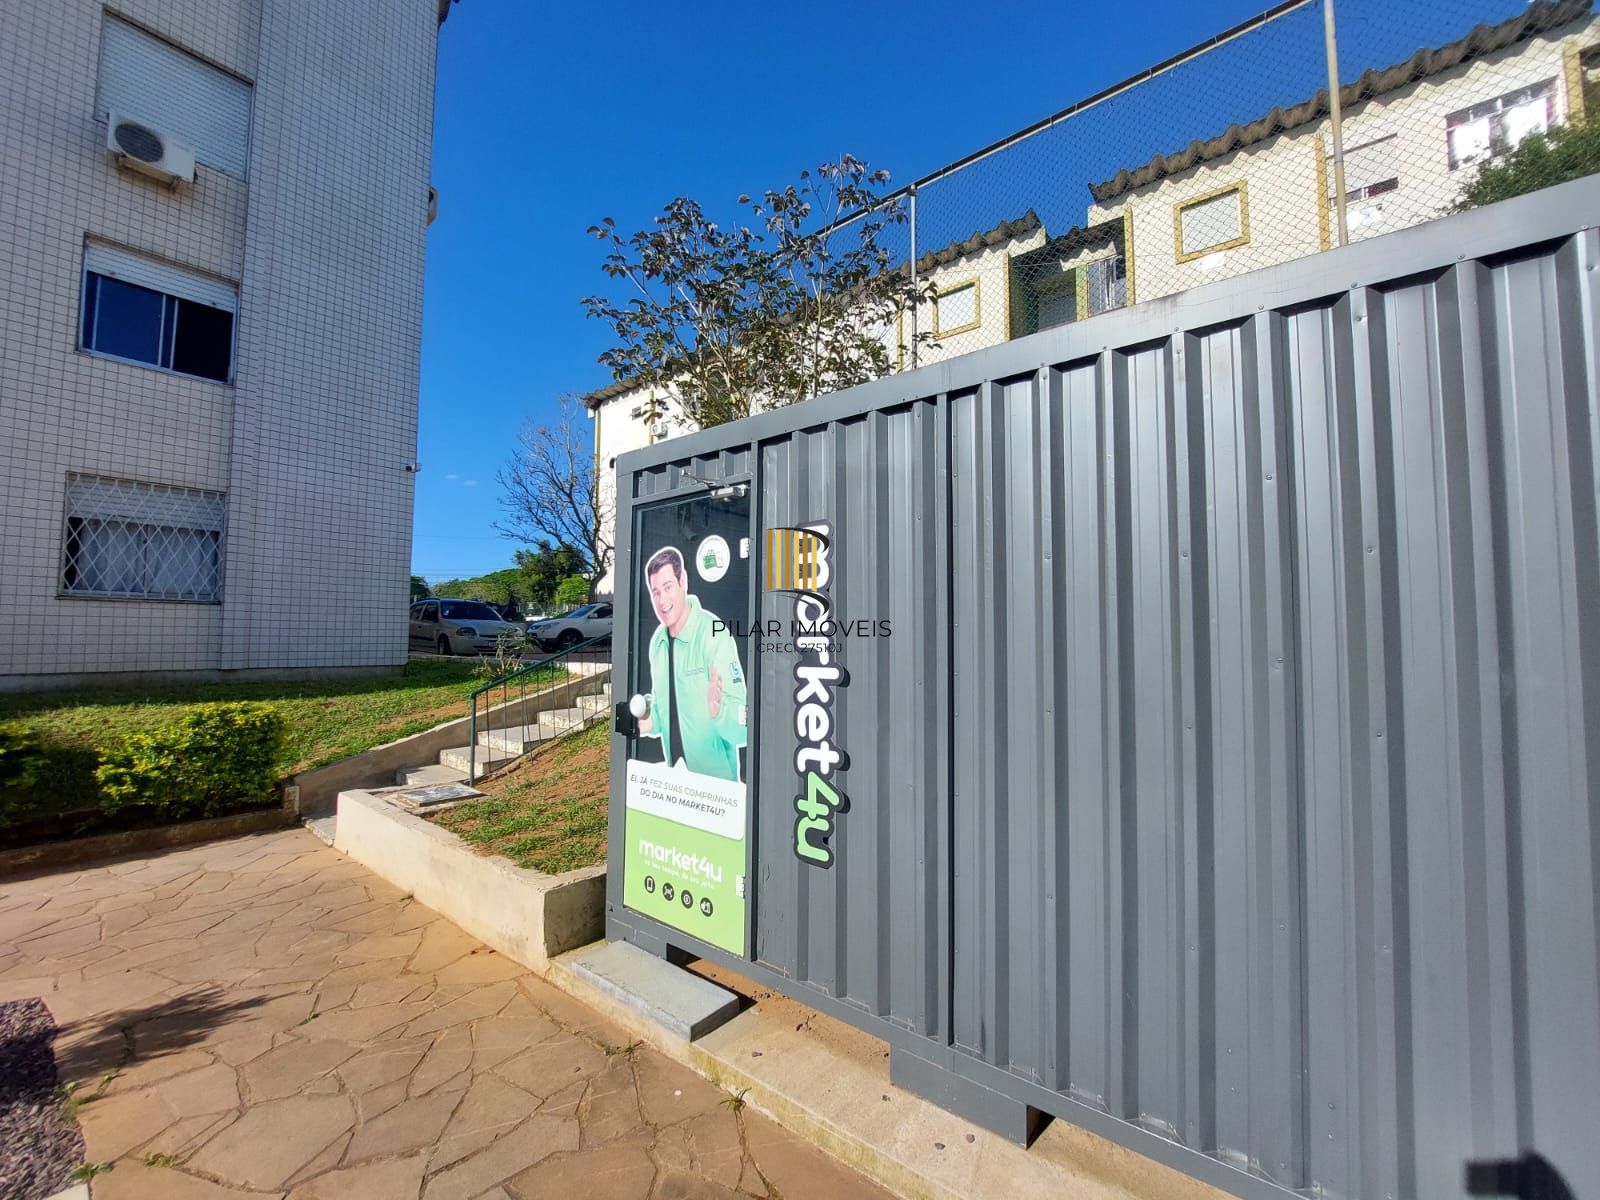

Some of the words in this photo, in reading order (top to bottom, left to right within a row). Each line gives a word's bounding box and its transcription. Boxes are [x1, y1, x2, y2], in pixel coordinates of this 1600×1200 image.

[797, 524, 840, 862] market4u
[640, 776, 648, 785] JÁ
[649, 779, 661, 788] FEZ
[664, 782, 682, 793] SUAS
[684, 787, 738, 807] COMPRINHAS
[640, 788, 651, 797] DO
[652, 791, 664, 801] DIA
[666, 795, 677, 804] NO
[679, 799, 726, 816] MARKET4U?
[639, 839, 722, 882] market4u
